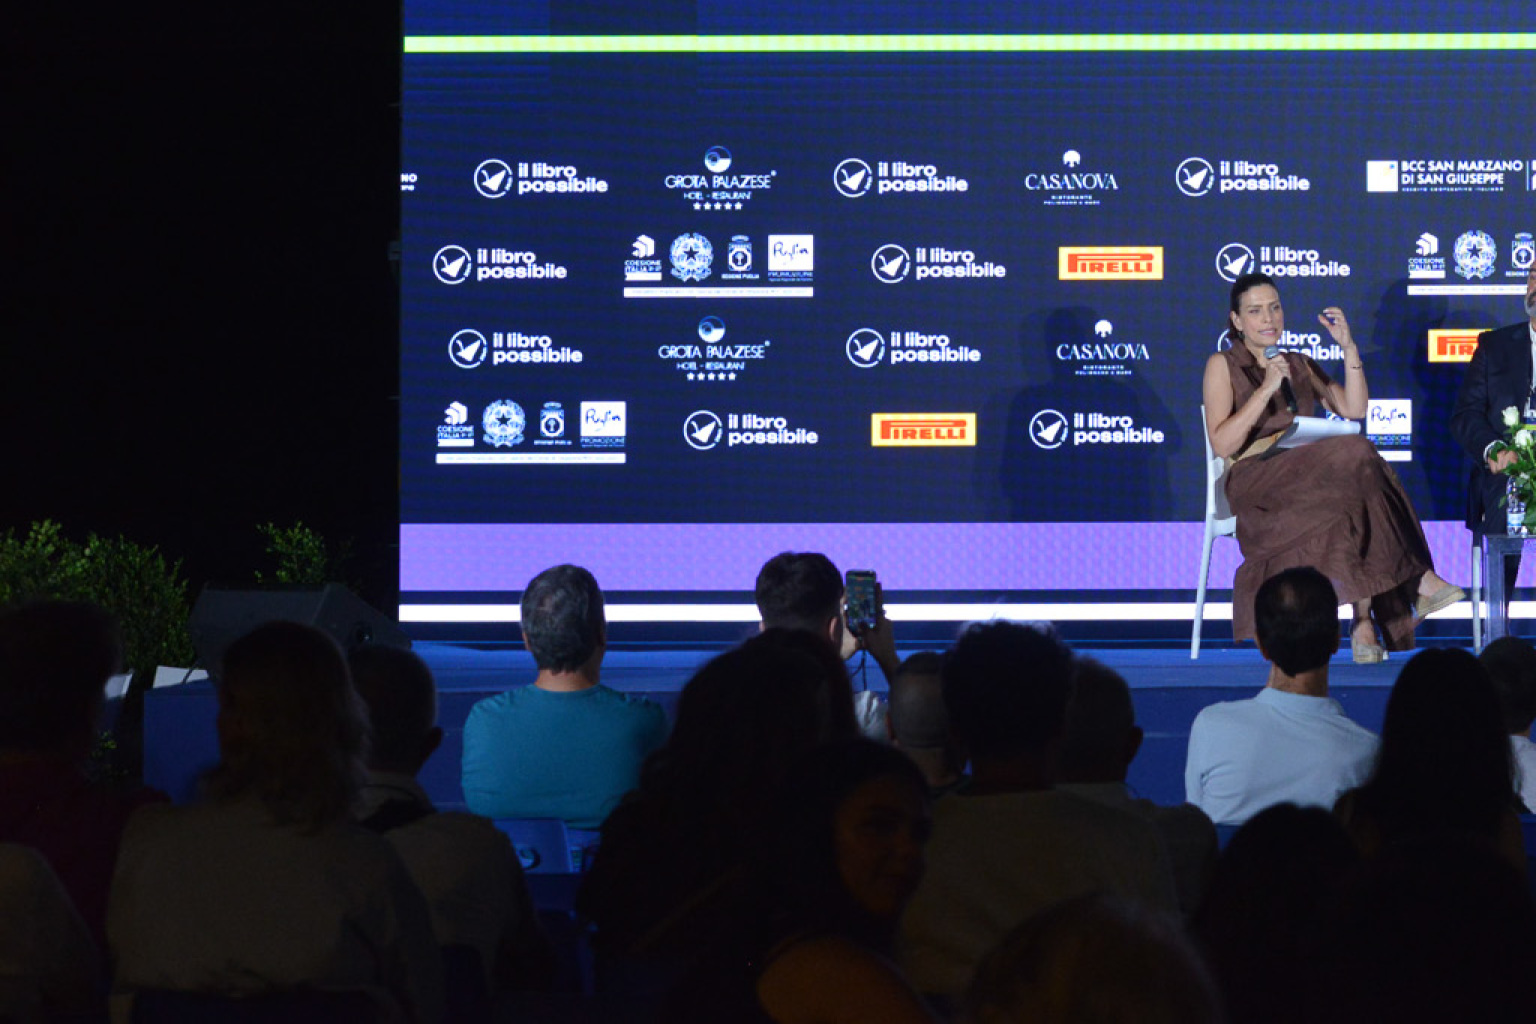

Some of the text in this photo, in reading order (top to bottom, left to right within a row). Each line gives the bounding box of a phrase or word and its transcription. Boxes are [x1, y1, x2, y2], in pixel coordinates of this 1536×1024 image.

[518, 162, 577, 178] il libro
[878, 161, 937, 177] il libro
[1220, 160, 1279, 176] il libro
[1400, 159, 1524, 172] BCC SAN MARZANO
[518, 177, 609, 195] possibile
[878, 176, 969, 194] possibile
[1024, 172, 1119, 191] CASANOVA
[1220, 175, 1311, 193] possibile
[1400, 172, 1504, 185] DI SAN GIUSEPPE
[476, 247, 535, 263] il libro
[915, 246, 974, 262] il libro
[1260, 245, 1319, 261] il libro
[476, 262, 567, 280] possibile
[915, 261, 1006, 279] possibile
[1067, 252, 1154, 274] PIRELLI
[1260, 260, 1351, 278] possibile
[492, 331, 551, 347] il libro
[890, 330, 949, 346] il libro
[492, 346, 583, 364] possibile
[890, 345, 981, 363] possibile
[1055, 342, 1150, 361] CASANOVA
[728, 413, 787, 429] il libro
[1073, 412, 1132, 428] il libro
[728, 428, 819, 446] possibile
[880, 419, 967, 441] PIRELLI
[1073, 427, 1164, 445] possibile
